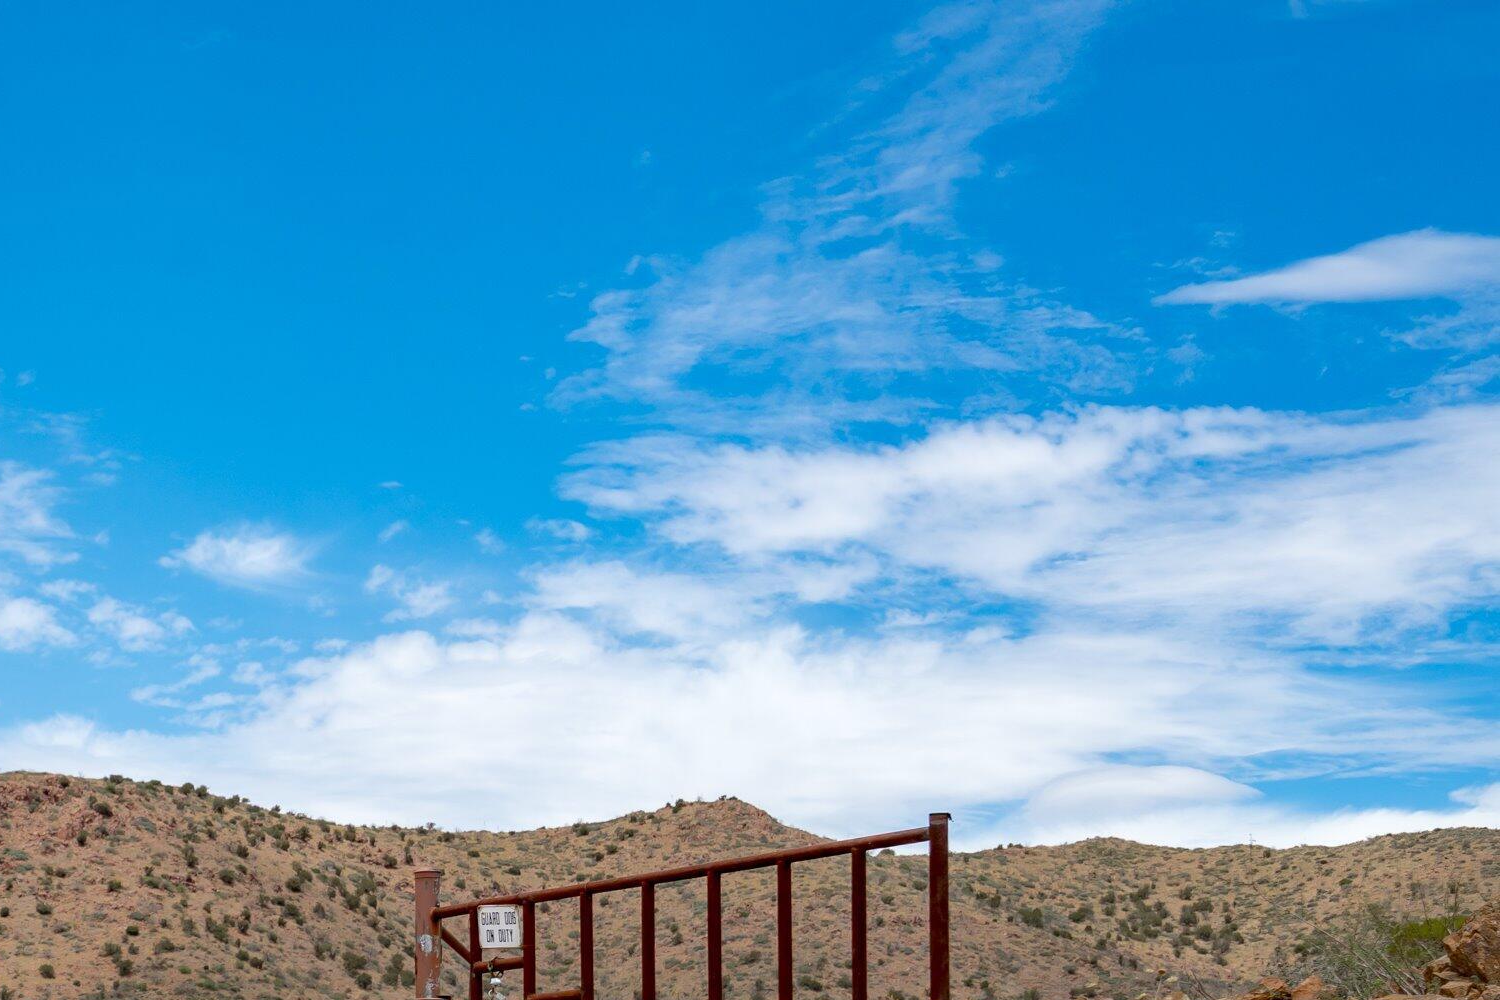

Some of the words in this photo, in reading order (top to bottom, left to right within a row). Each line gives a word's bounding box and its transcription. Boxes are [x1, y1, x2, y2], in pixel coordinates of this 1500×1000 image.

[480, 911, 500, 926] GUARD
[504, 911, 517, 925] DOG
[486, 929, 495, 942] ON
[498, 929, 513, 942] DUTY
